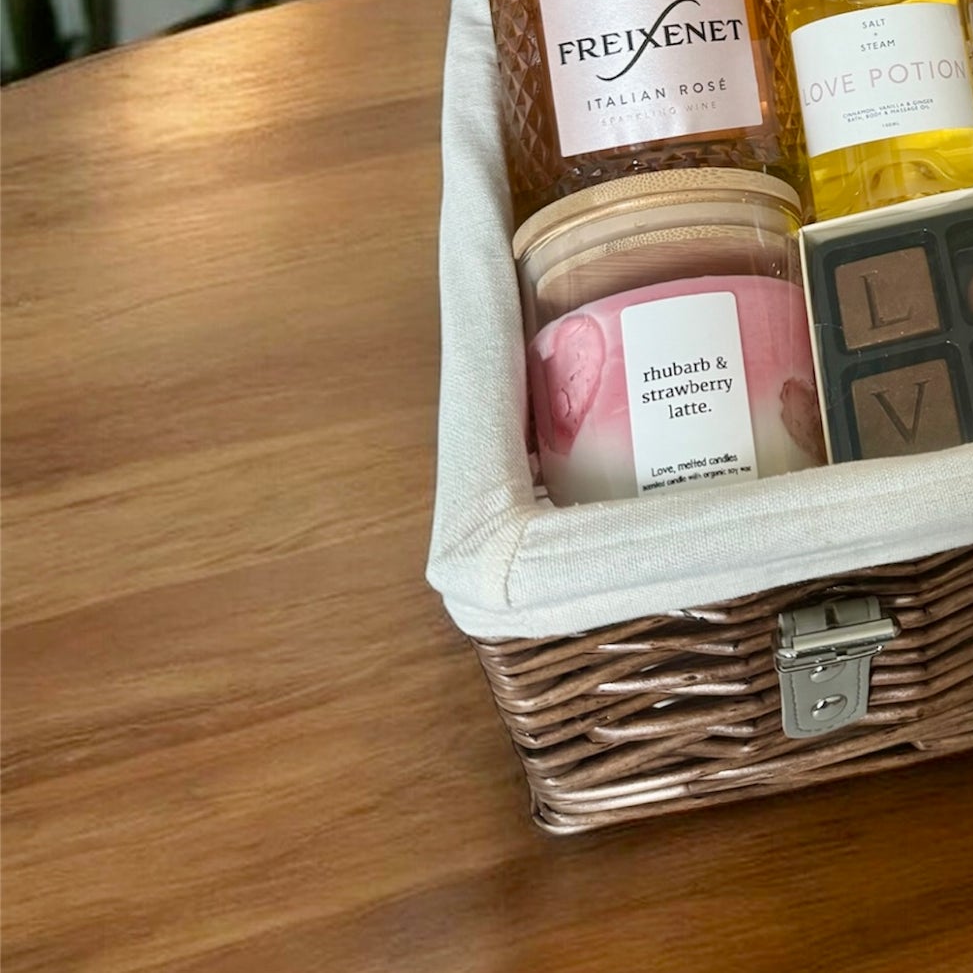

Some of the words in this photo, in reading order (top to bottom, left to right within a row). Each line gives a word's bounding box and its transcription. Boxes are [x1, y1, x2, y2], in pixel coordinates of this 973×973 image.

[861, 18, 886, 29] SALT
[860, 39, 896, 52] STEAM
[587, 87, 667, 111] ITALIAN
[680, 78, 728, 95] ROSÉ
[802, 73, 856, 106] LOVE
[869, 59, 966, 88] POTION
[686, 101, 717, 111] WINE
[860, 270, 912, 330] L
[643, 357, 711, 383] rhubarb
[716, 356, 728, 369] &
[642, 377, 733, 404] strawberry
[668, 401, 712, 420] latte.
[871, 379, 930, 445] V
[651, 465, 676, 477] Love,
[677, 457, 707, 471] melted
[709, 453, 738, 465] candles
